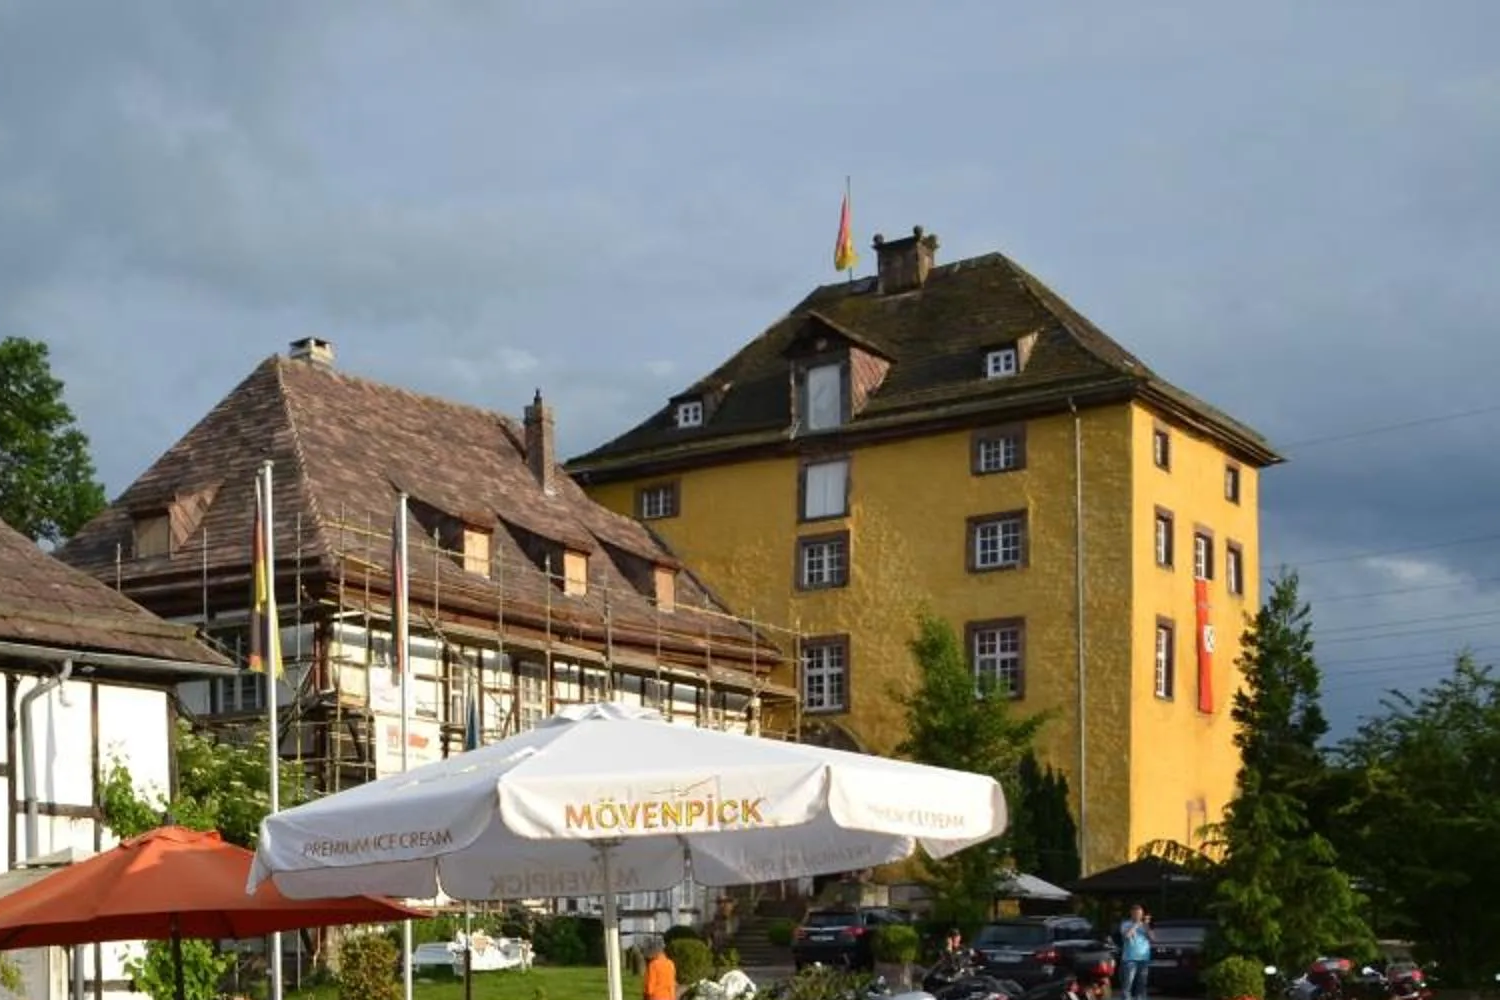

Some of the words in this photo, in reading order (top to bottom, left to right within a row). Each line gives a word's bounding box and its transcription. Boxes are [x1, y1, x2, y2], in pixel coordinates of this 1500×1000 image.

[303, 837, 372, 857] PREMIUM
[374, 834, 397, 850] ICE
[399, 829, 453, 849] CREAM
